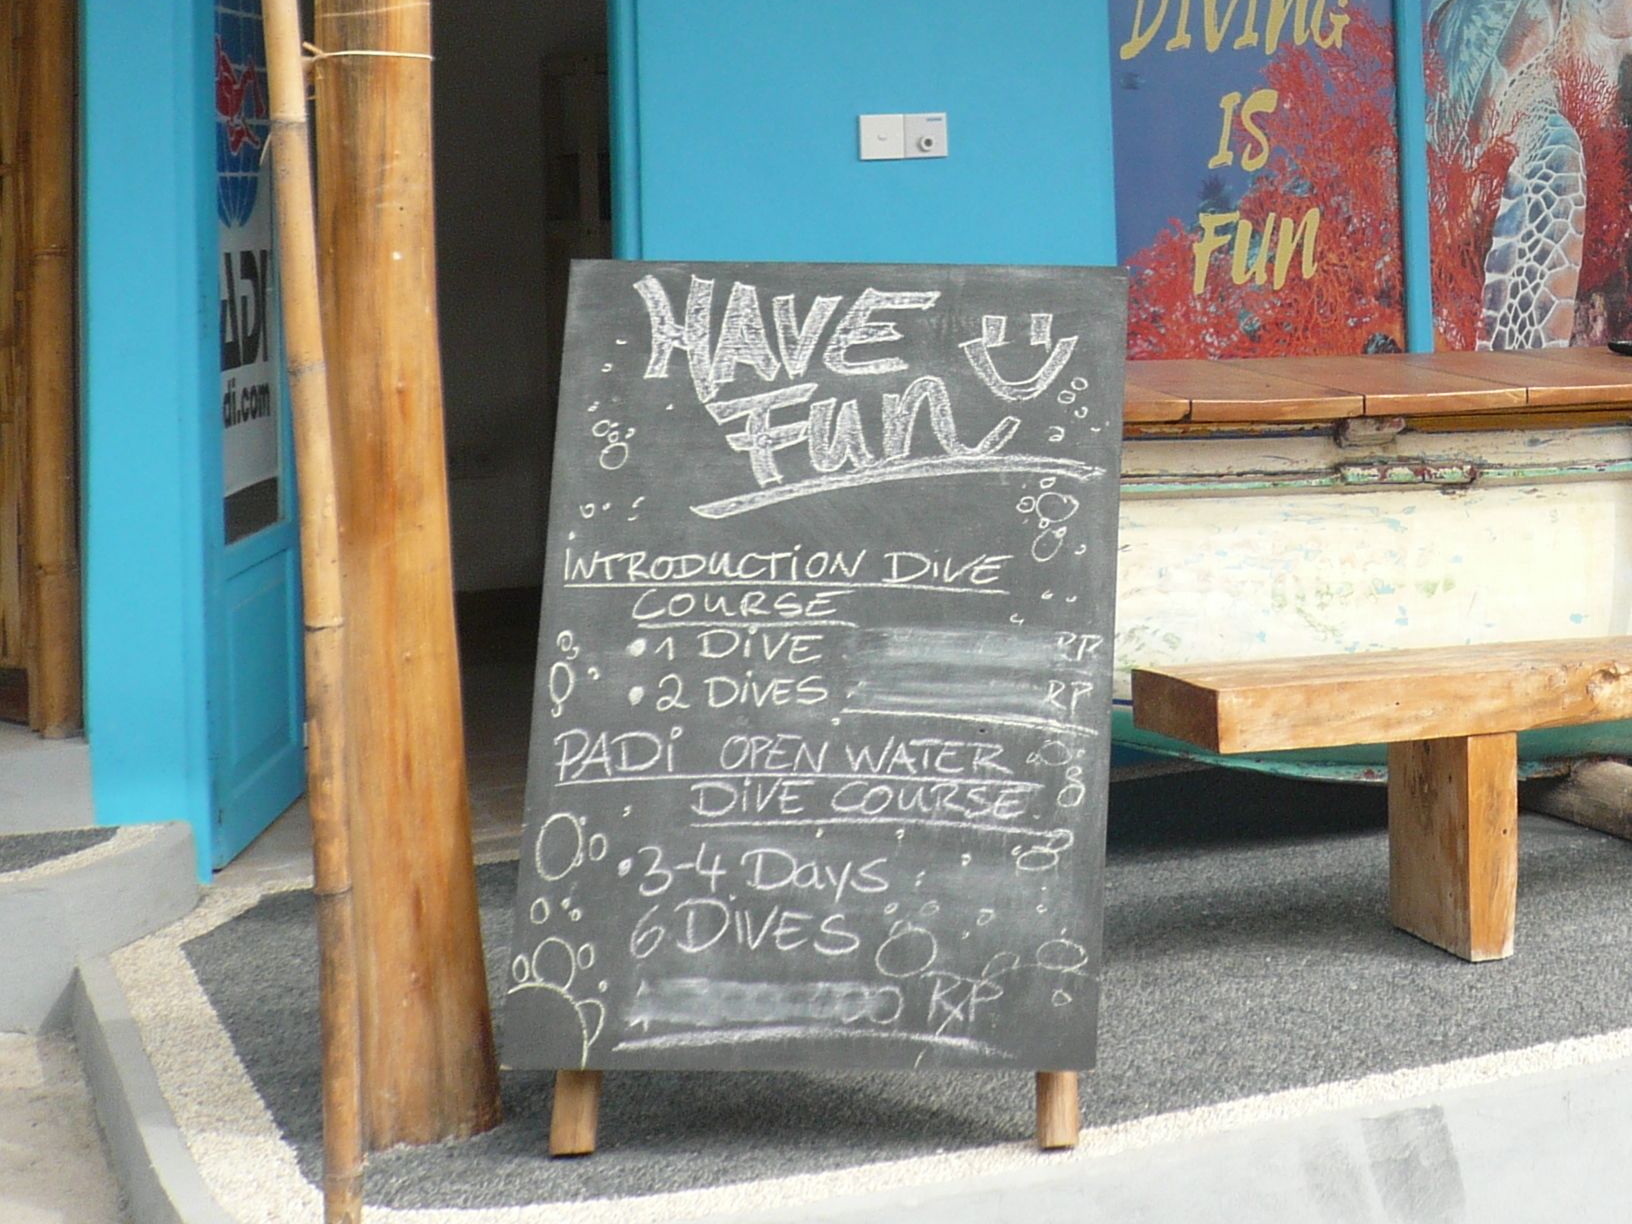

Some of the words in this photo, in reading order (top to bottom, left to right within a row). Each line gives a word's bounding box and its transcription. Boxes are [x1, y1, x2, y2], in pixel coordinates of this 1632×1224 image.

[1208, 89, 1278, 171] IS
[1192, 207, 1321, 295] FUN
[633, 273, 941, 403] HAVE
[653, 635, 678, 659] 1
[655, 673, 691, 709] 2
[719, 735, 829, 772] OPEN
[845, 736, 1014, 775] WATER
[638, 842, 728, 896] 3-4
[740, 847, 890, 903] Days
[630, 905, 666, 959] 6
